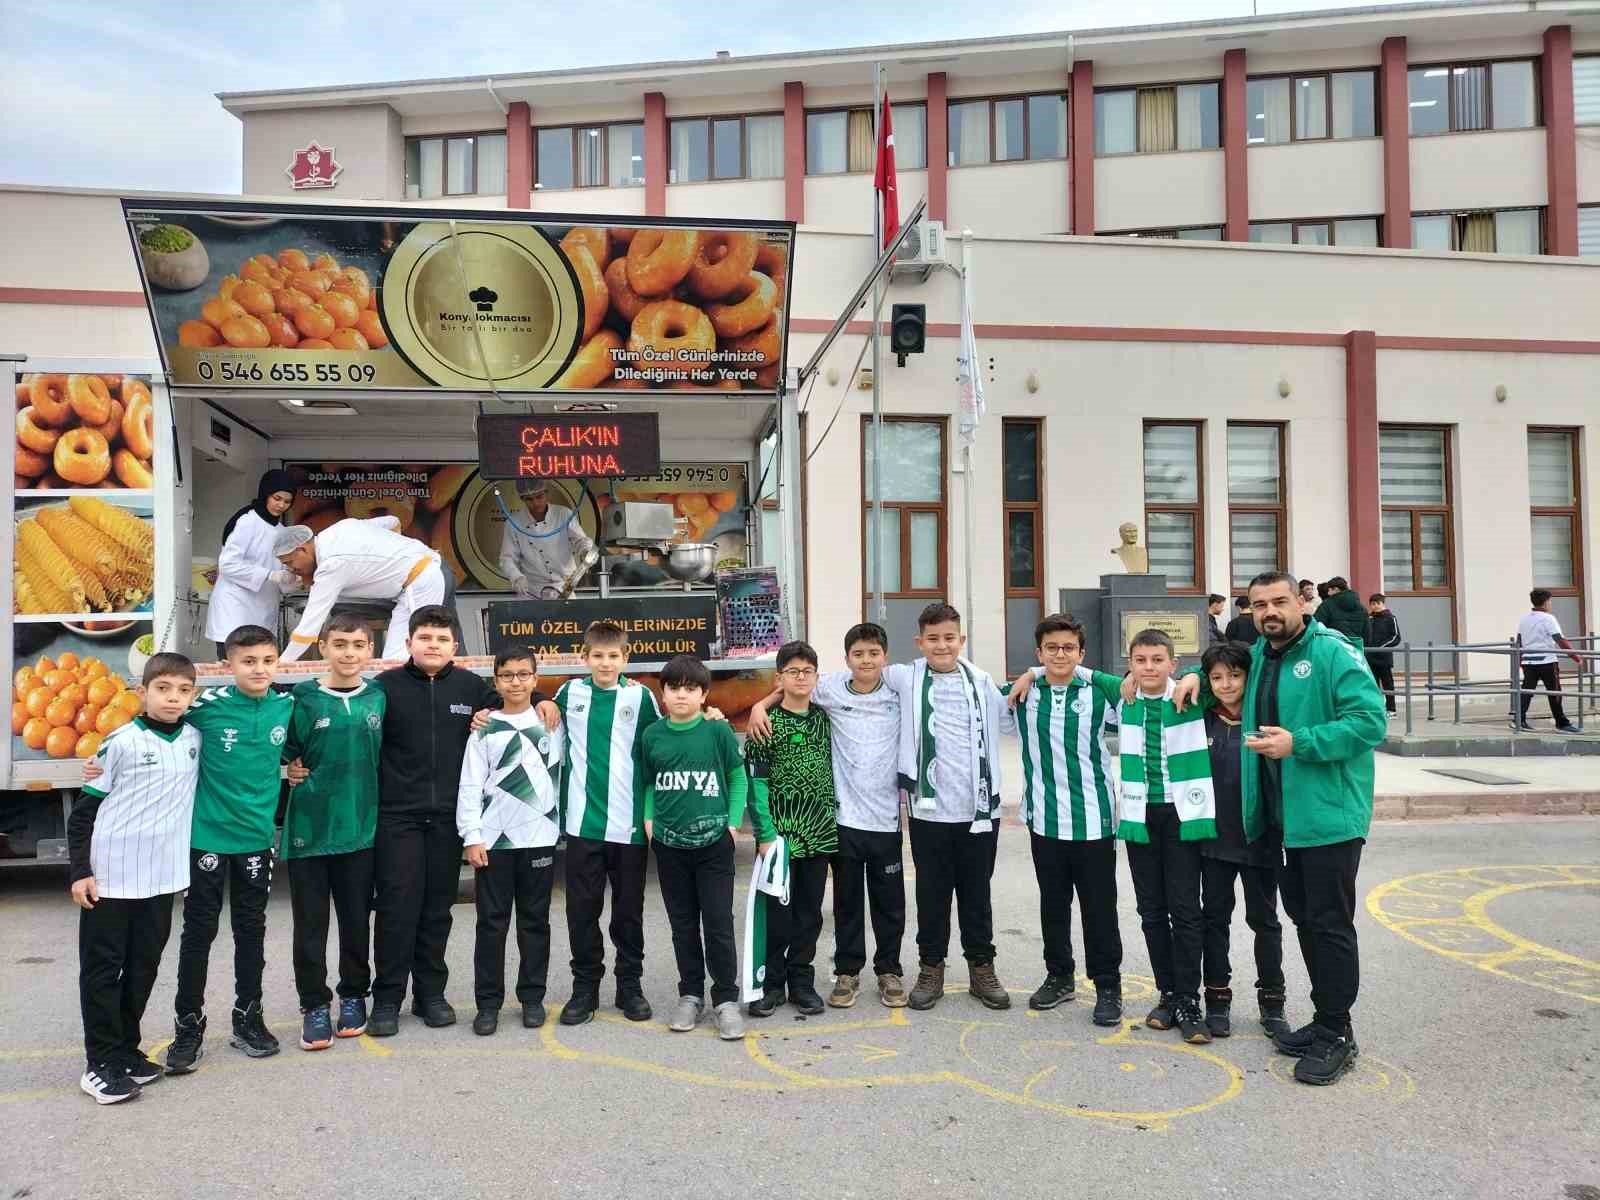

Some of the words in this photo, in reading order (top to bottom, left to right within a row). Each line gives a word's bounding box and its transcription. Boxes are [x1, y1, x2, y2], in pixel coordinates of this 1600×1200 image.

[439, 312, 473, 323] Kony
[609, 348, 640, 361] Tüm
[643, 345, 674, 362] Özel
[677, 349, 765, 362] Günlerinizde
[198, 361, 214, 380] 0
[220, 362, 263, 381] 546
[269, 363, 309, 382] 655
[315, 364, 342, 382] 55
[347, 364, 376, 382] 09
[614, 368, 688, 382] Dilediğiniz
[691, 368, 715, 380] Her
[717, 368, 758, 380] Yerde
[521, 426, 620, 453] ÇALIK'IN
[519, 454, 625, 476] RUHUNA.
[686, 467, 714, 482] 546
[718, 467, 729, 482] 0
[500, 621, 534, 636] TÜM
[541, 619, 583, 634] ÖZEL
[591, 617, 707, 632] NLERİNİZDE
